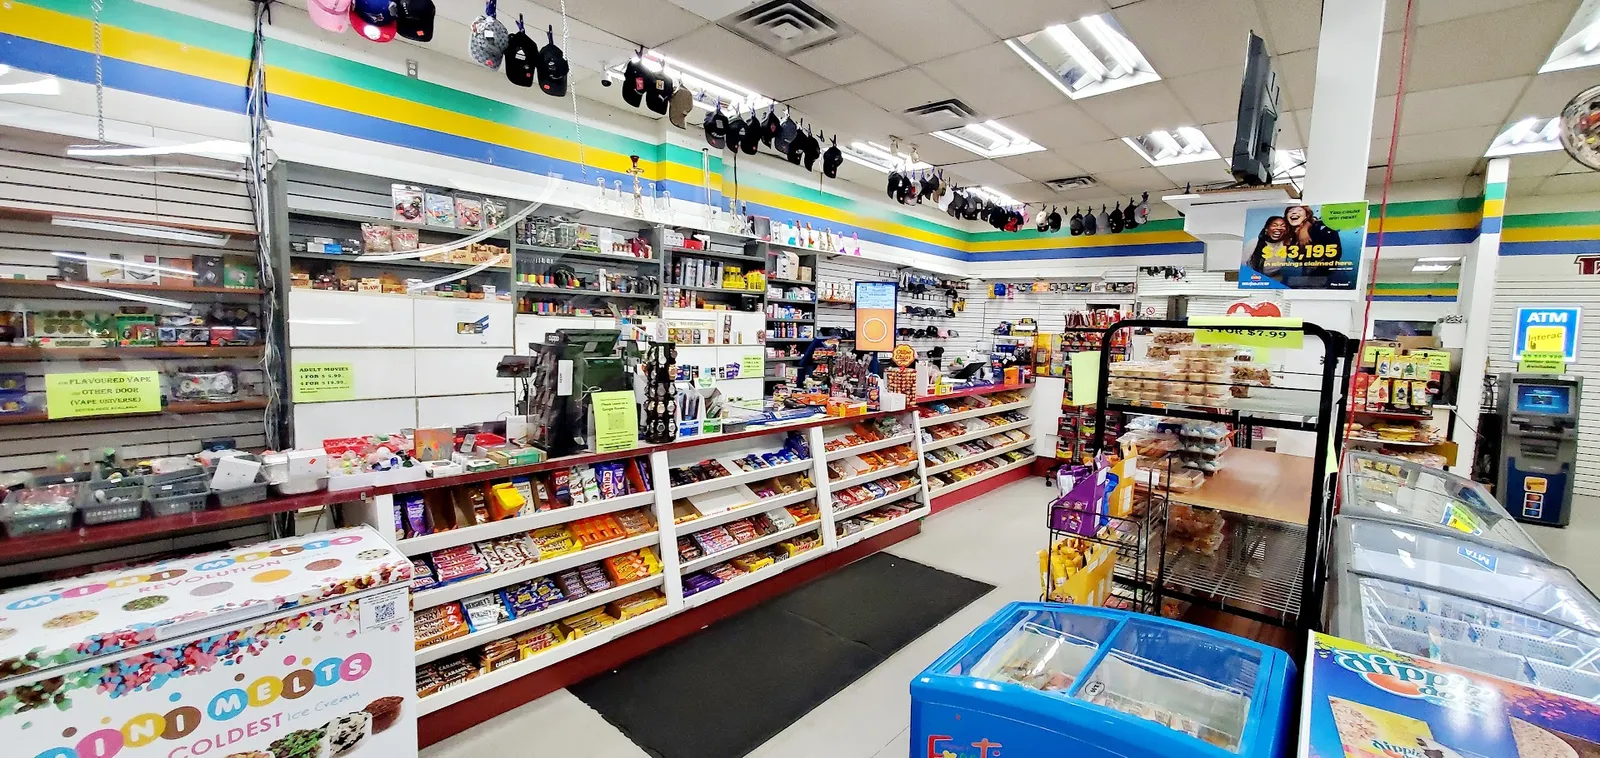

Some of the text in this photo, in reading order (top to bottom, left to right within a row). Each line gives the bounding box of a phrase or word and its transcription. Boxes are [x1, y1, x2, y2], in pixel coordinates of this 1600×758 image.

[1262, 244, 1338, 260] $43,195
[1526, 312, 1568, 322] ATM
[1248, 330, 1287, 338] $7.99
[1528, 332, 1563, 342] Interac
[12, 536, 360, 610] MINI MELTS
[139, 560, 282, 592] REVOLUTION
[444, 664, 470, 677] CARAMILK
[211, 656, 368, 718] MELTS
[169, 690, 361, 758] COLDEST Ice Cream
